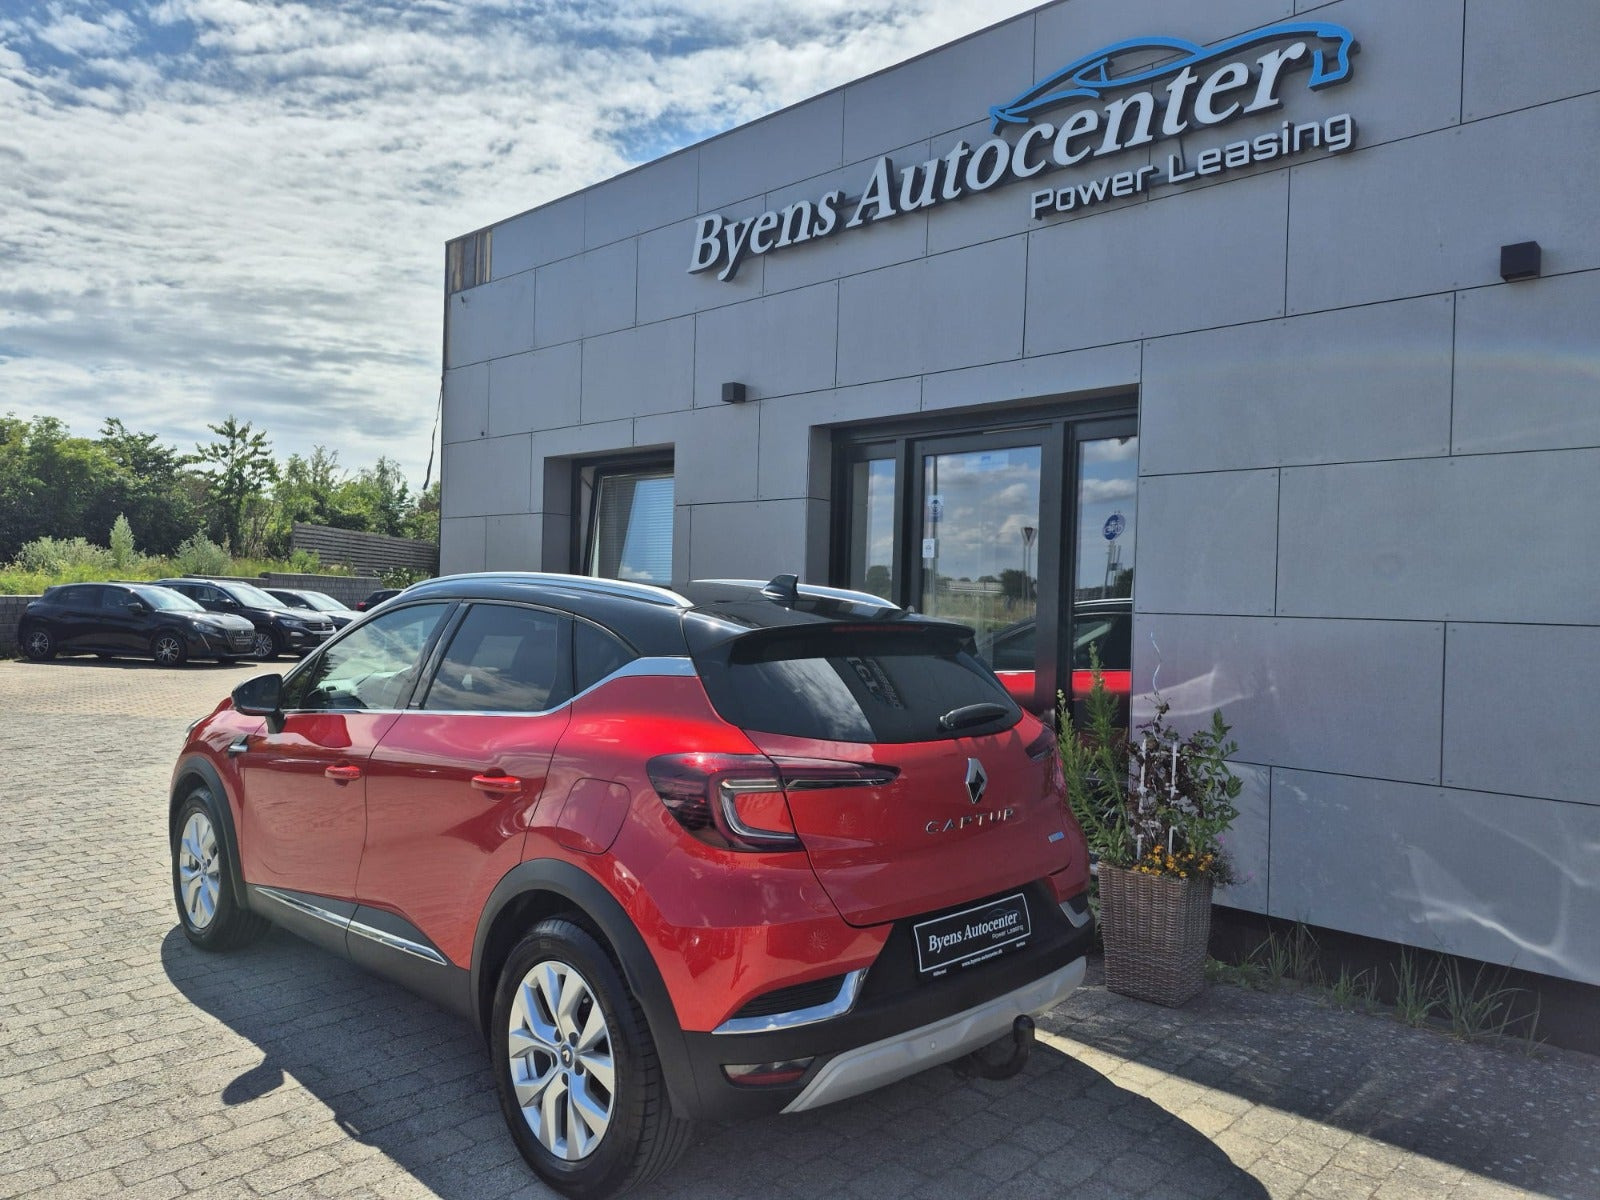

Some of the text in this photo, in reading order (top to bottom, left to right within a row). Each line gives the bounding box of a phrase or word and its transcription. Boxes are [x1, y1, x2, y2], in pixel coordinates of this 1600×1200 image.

[688, 42, 1307, 281] Byens Autocenter
[1031, 113, 1352, 219] Power Leasing
[925, 808, 1014, 834] CAPTUR
[928, 912, 1018, 954] Byens Autocenter
